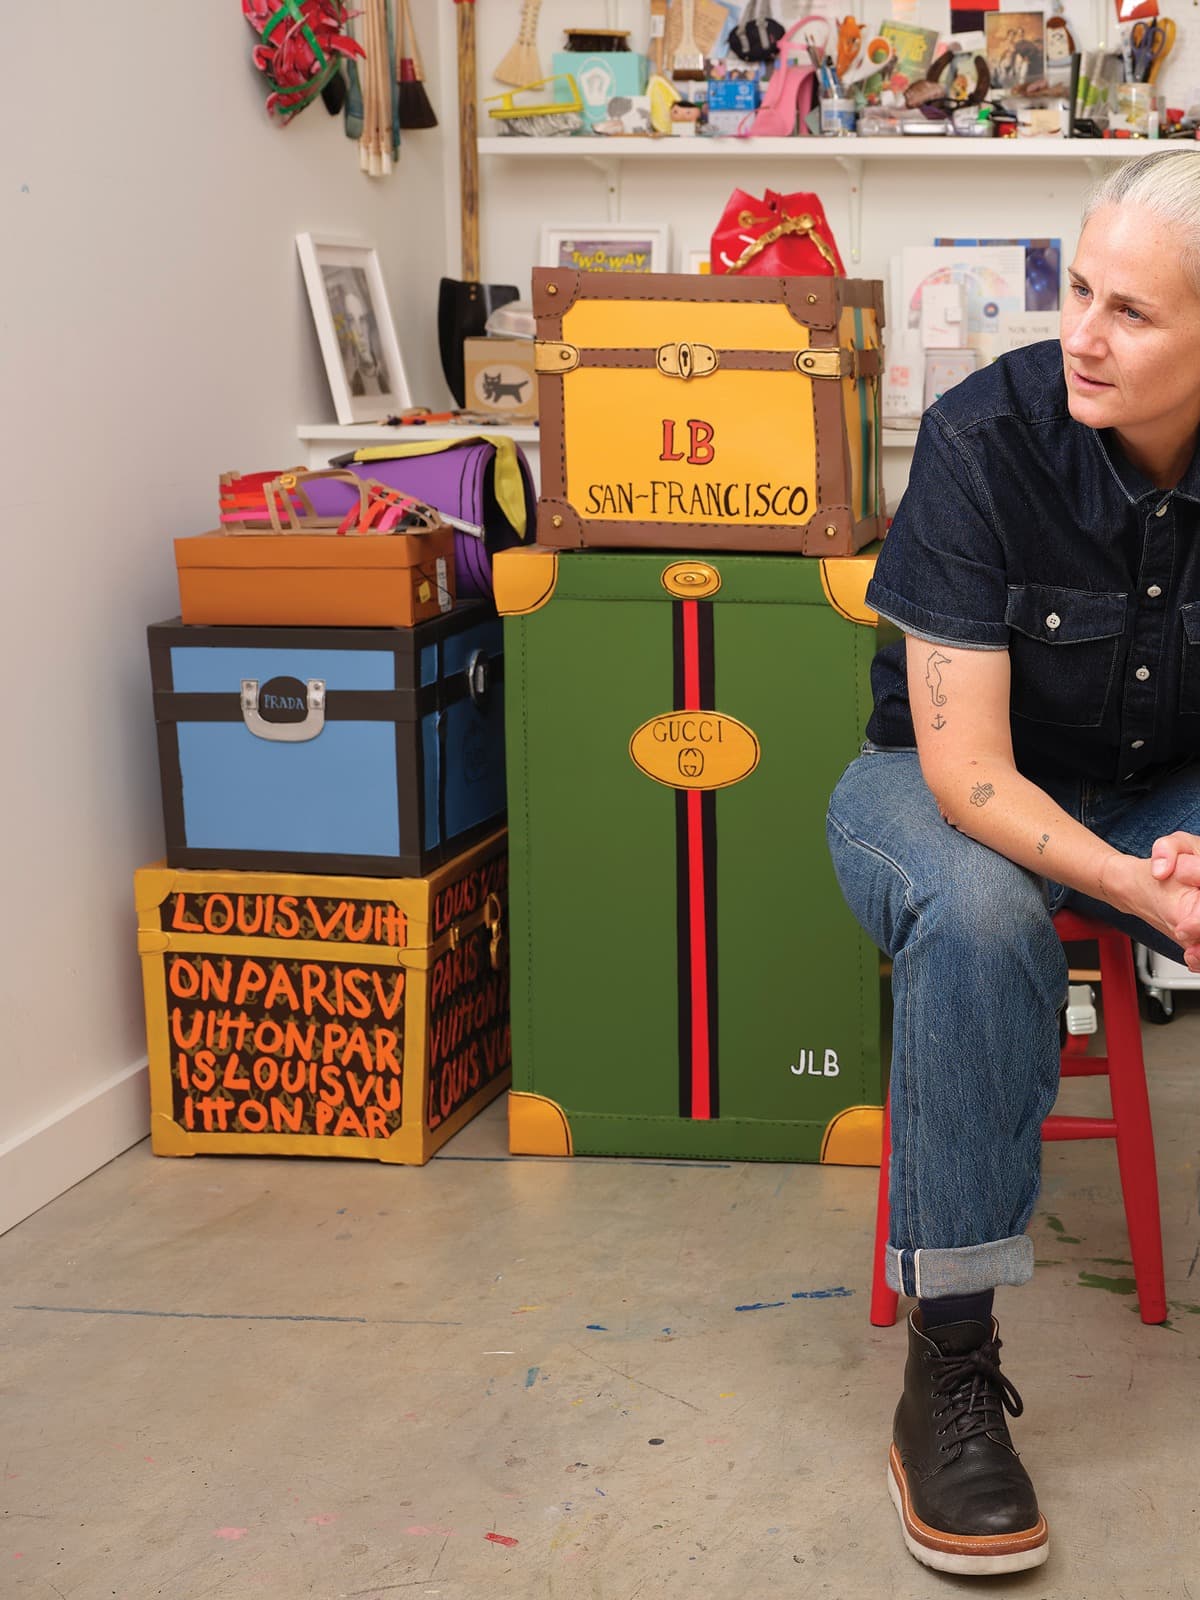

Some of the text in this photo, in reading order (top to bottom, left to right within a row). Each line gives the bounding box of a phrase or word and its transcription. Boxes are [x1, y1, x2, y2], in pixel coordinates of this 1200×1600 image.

[659, 418, 715, 465] LB
[263, 694, 305, 710] PRADA
[652, 720, 723, 743] GUCCI
[1036, 833, 1050, 855] JLB
[171, 892, 301, 938] LOUIS
[435, 871, 477, 932] LOUIS
[790, 1048, 840, 1077] JLB
[428, 1040, 479, 1129] LOUIS
[316, 1100, 391, 1138] PAR
